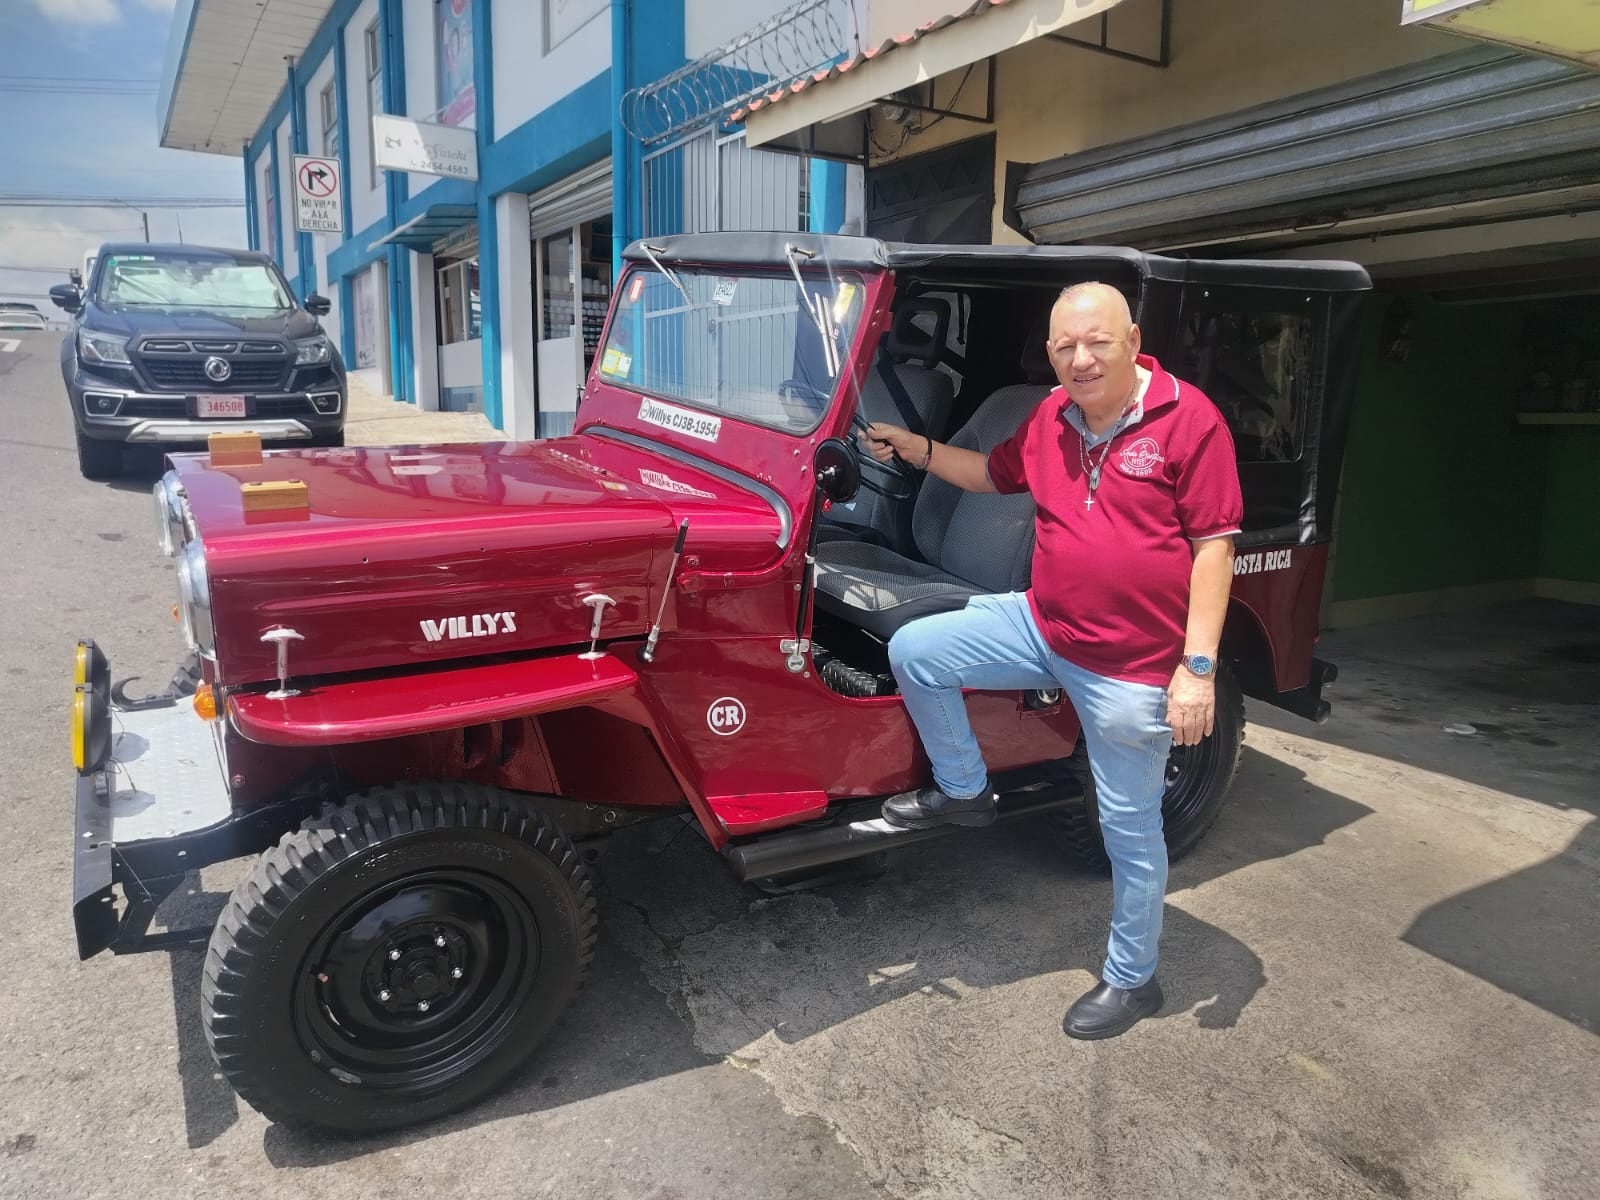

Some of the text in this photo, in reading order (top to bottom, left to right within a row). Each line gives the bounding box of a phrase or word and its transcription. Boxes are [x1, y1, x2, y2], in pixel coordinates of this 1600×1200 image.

[420, 160, 469, 175] 2454-4583
[301, 198, 337, 209] NO VIRAR
[311, 209, 317, 218] A
[302, 220, 338, 230] DERECHA
[207, 401, 243, 412] 346508
[648, 405, 671, 425] Willys
[672, 413, 718, 438] CJ3B-1954
[1233, 549, 1292, 575] OSTA RICA
[420, 611, 517, 641] WILLYS
[711, 705, 740, 727] CR
